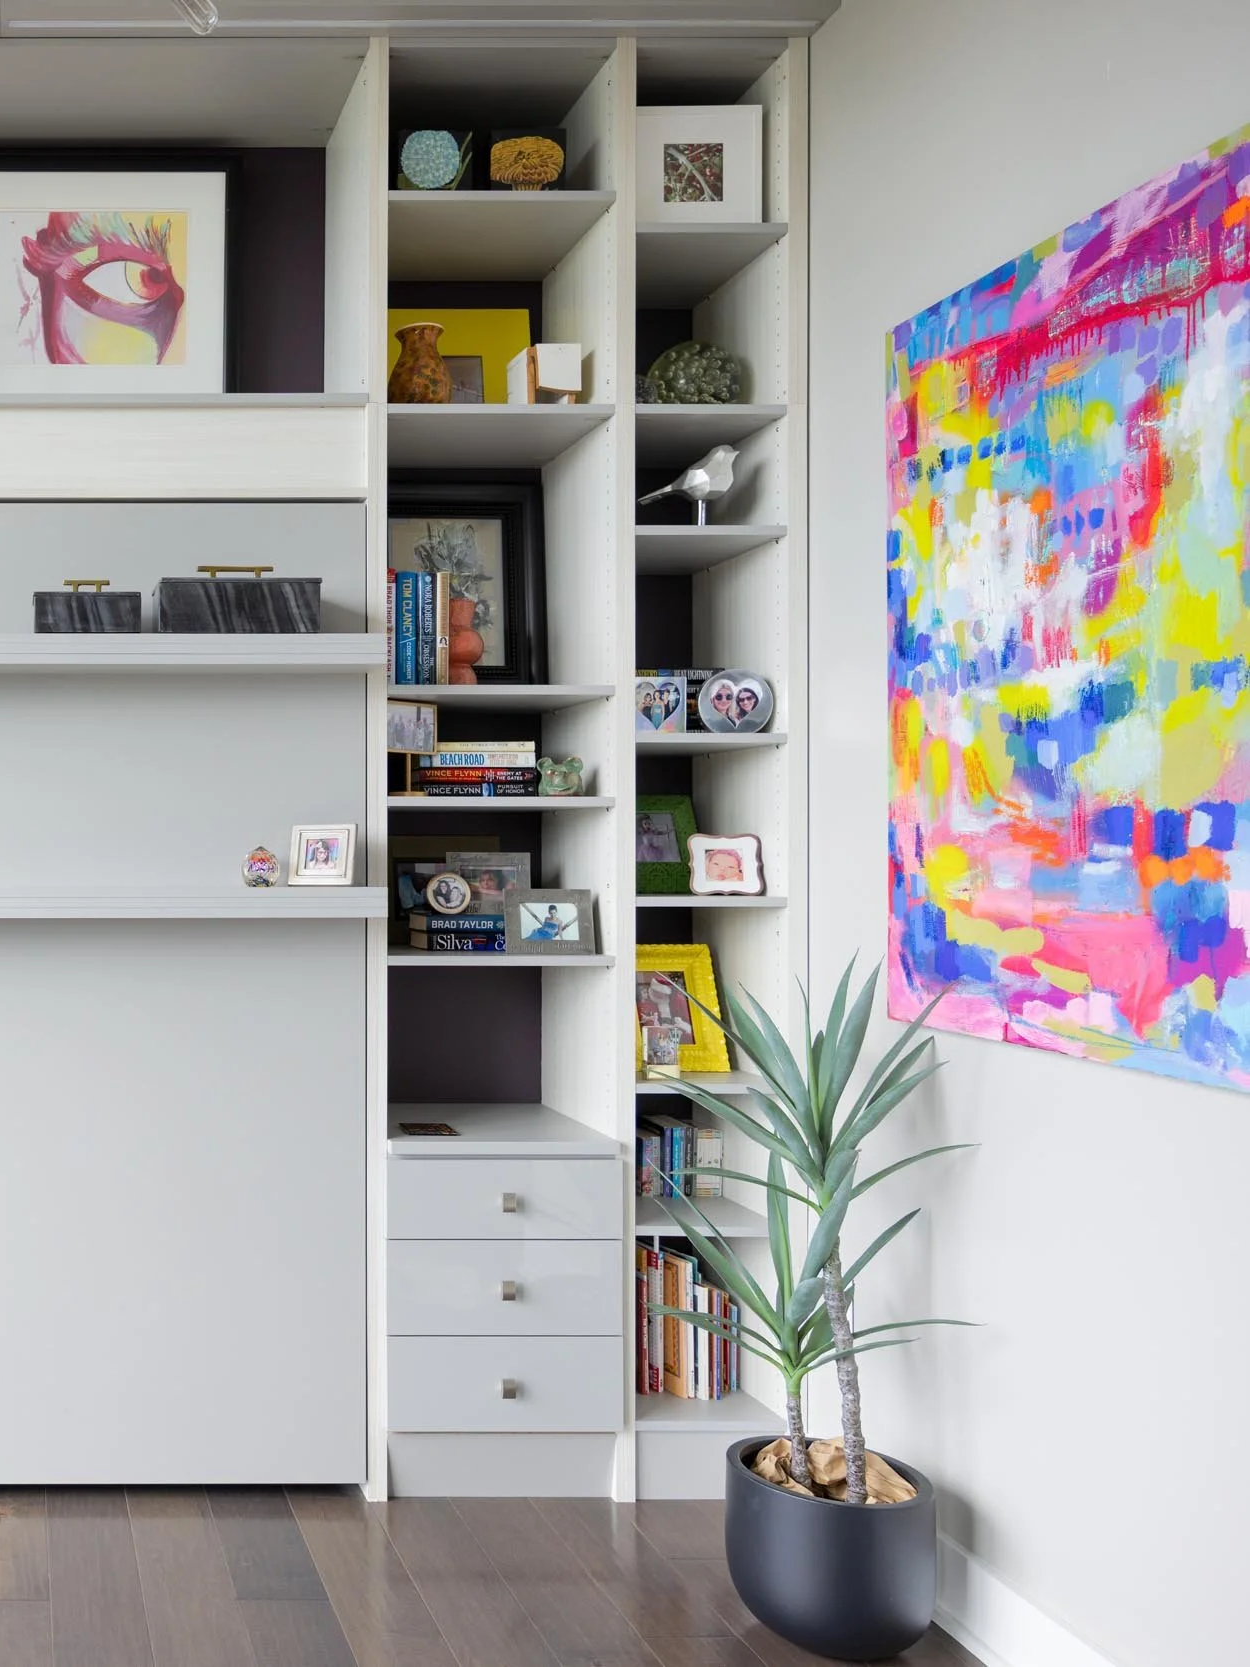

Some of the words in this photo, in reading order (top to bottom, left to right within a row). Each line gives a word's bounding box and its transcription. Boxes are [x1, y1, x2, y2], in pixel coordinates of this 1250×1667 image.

[402, 578, 413, 598] TOM
[424, 584, 433, 604] NORA
[402, 600, 413, 637] CLANCY
[424, 604, 433, 633] ROBERTS
[422, 644, 431, 678] OBSESSION
[439, 753, 463, 766] BEACH
[464, 753, 485, 766] ROAD
[425, 769, 452, 777] VINCE
[454, 769, 482, 777] FLYNN
[431, 920, 457, 929] BRAD
[458, 920, 494, 929] TAYLOR
[436, 933, 473, 950] Silva
